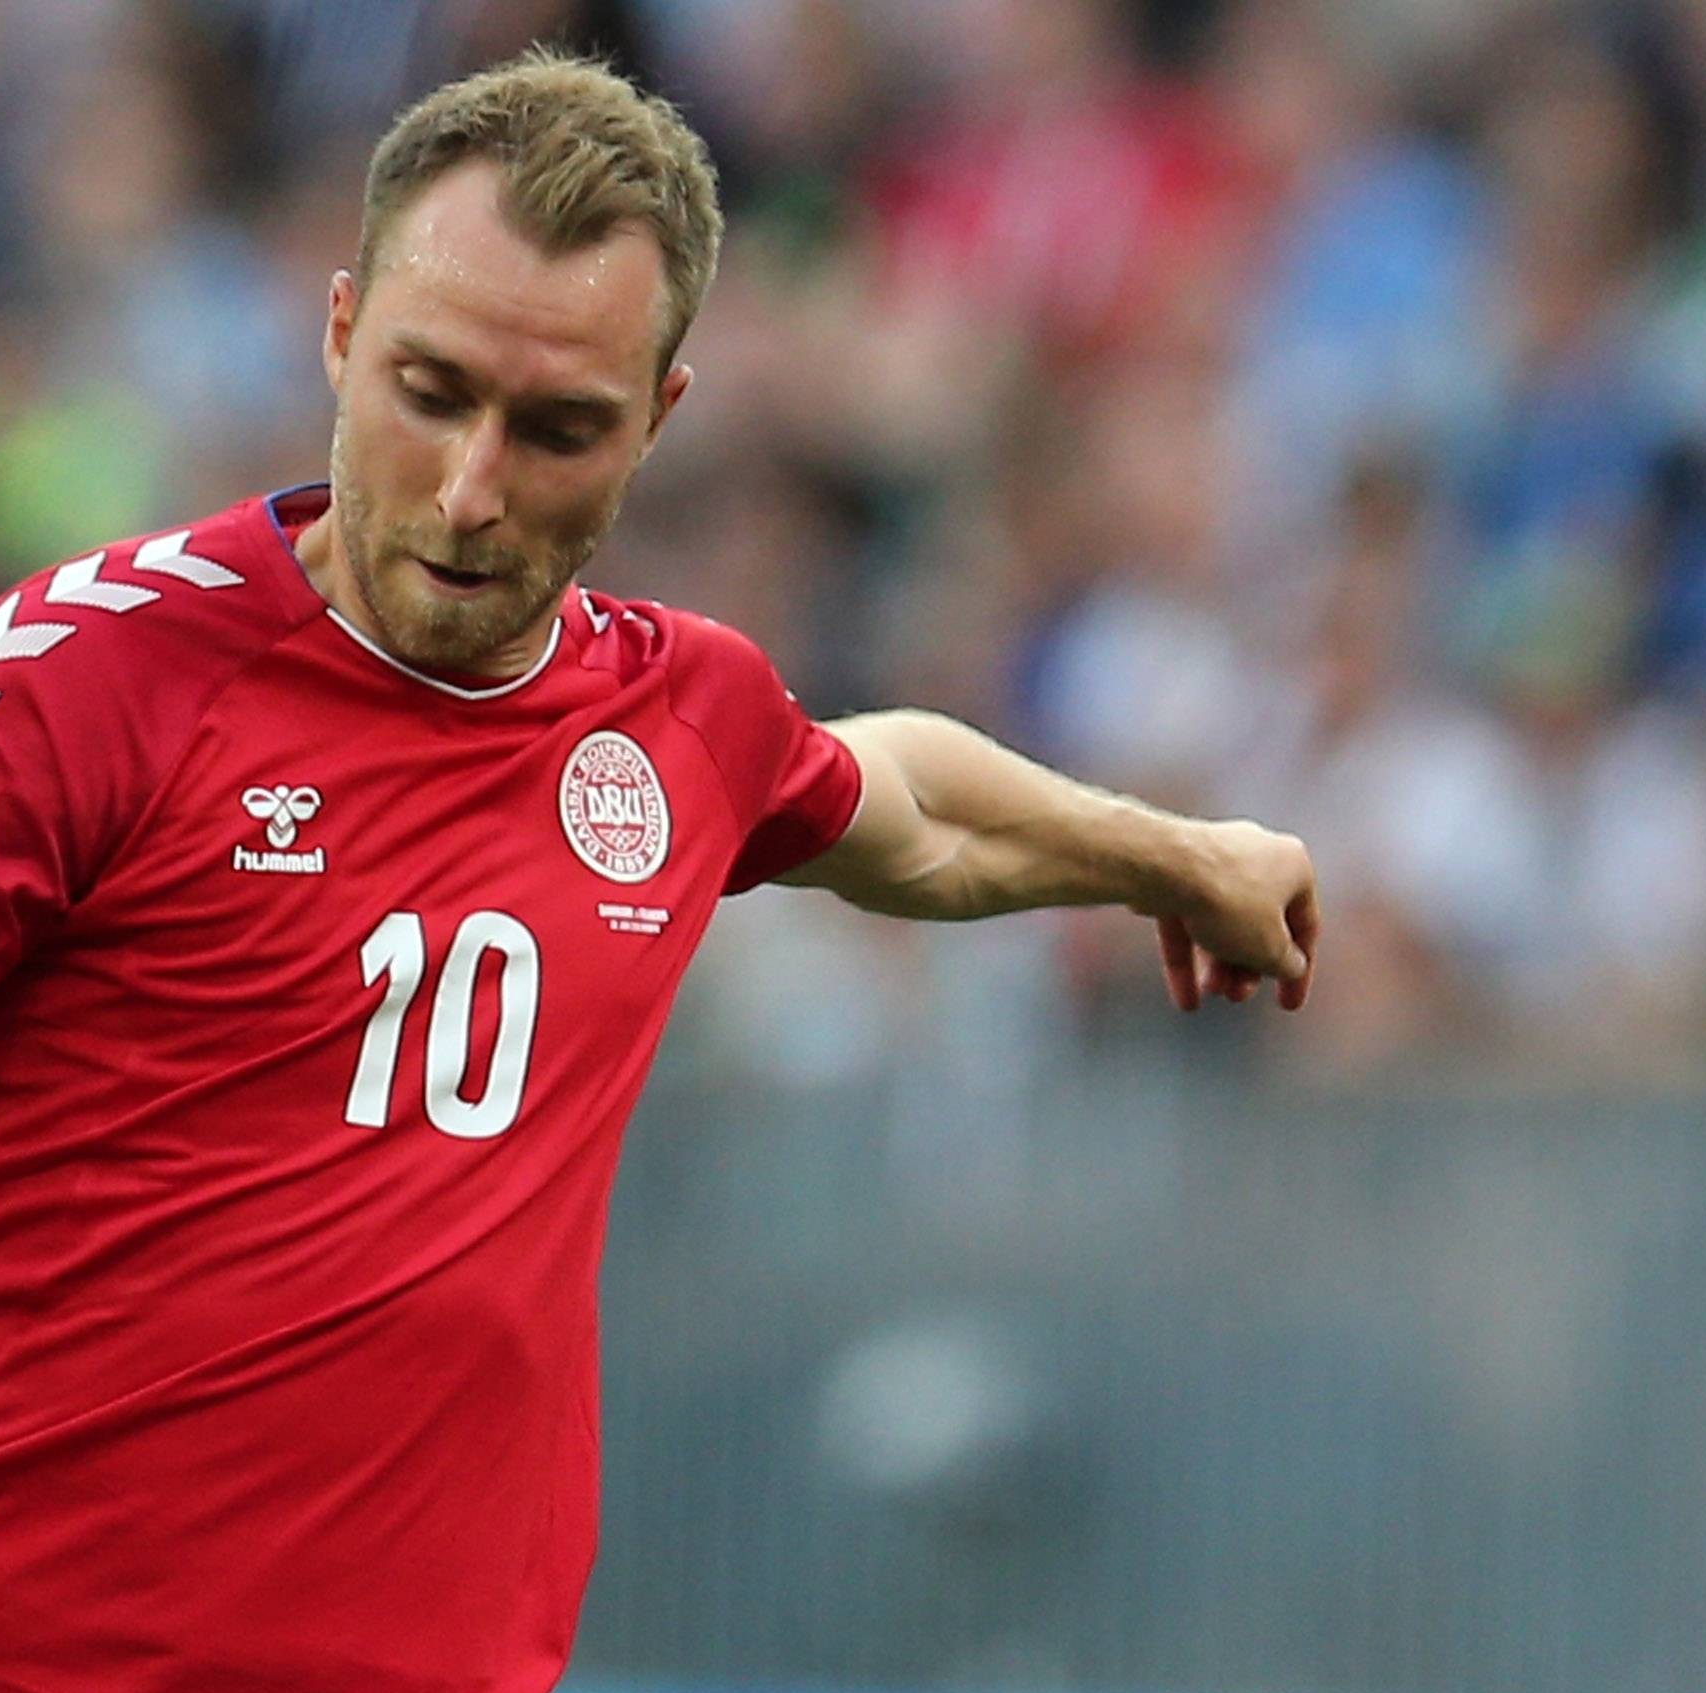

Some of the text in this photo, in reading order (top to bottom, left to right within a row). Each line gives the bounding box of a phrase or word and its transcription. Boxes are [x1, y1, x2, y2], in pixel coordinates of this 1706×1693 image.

[583, 783, 646, 826] DBU
[233, 844, 325, 874] hummel
[345, 910, 541, 1140] 10
